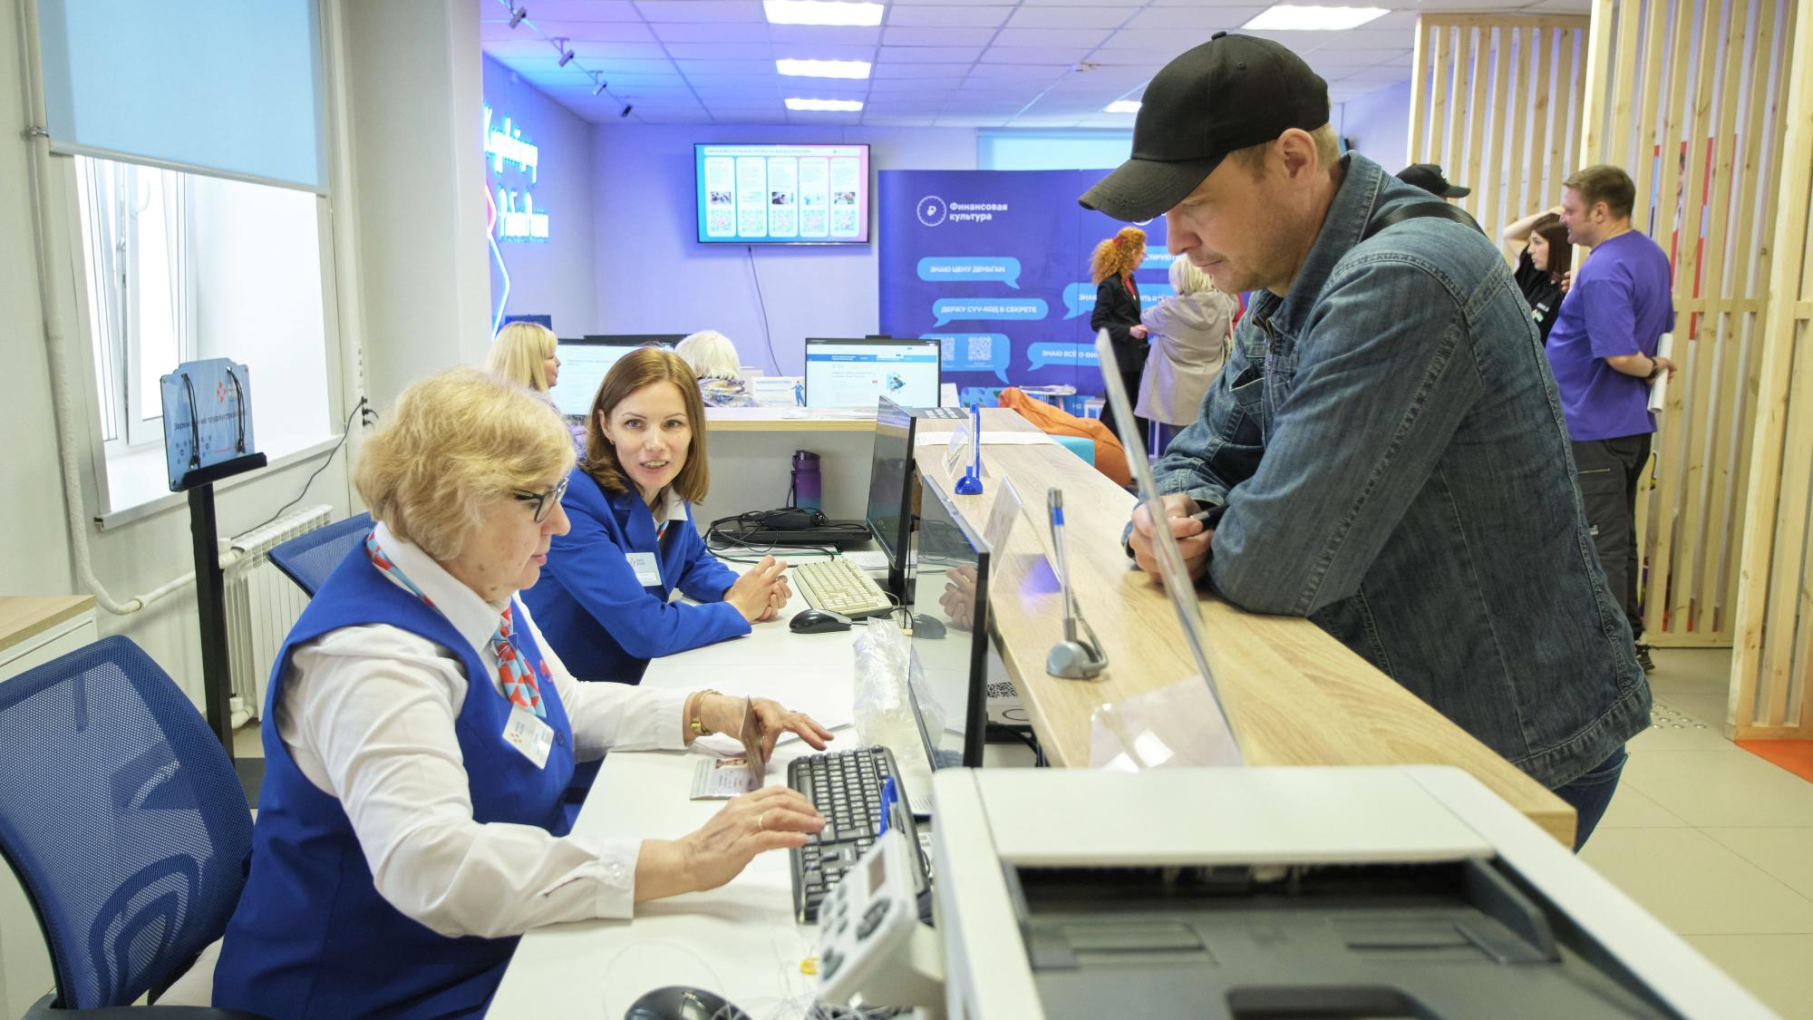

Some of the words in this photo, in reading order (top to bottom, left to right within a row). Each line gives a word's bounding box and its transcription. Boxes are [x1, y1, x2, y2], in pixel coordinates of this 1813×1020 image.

[949, 202, 1008, 211] Финансовая
[949, 213, 993, 223] культура
[967, 306, 998, 314] CVV-КОД
[1063, 349, 1077, 358] ВСЁ
